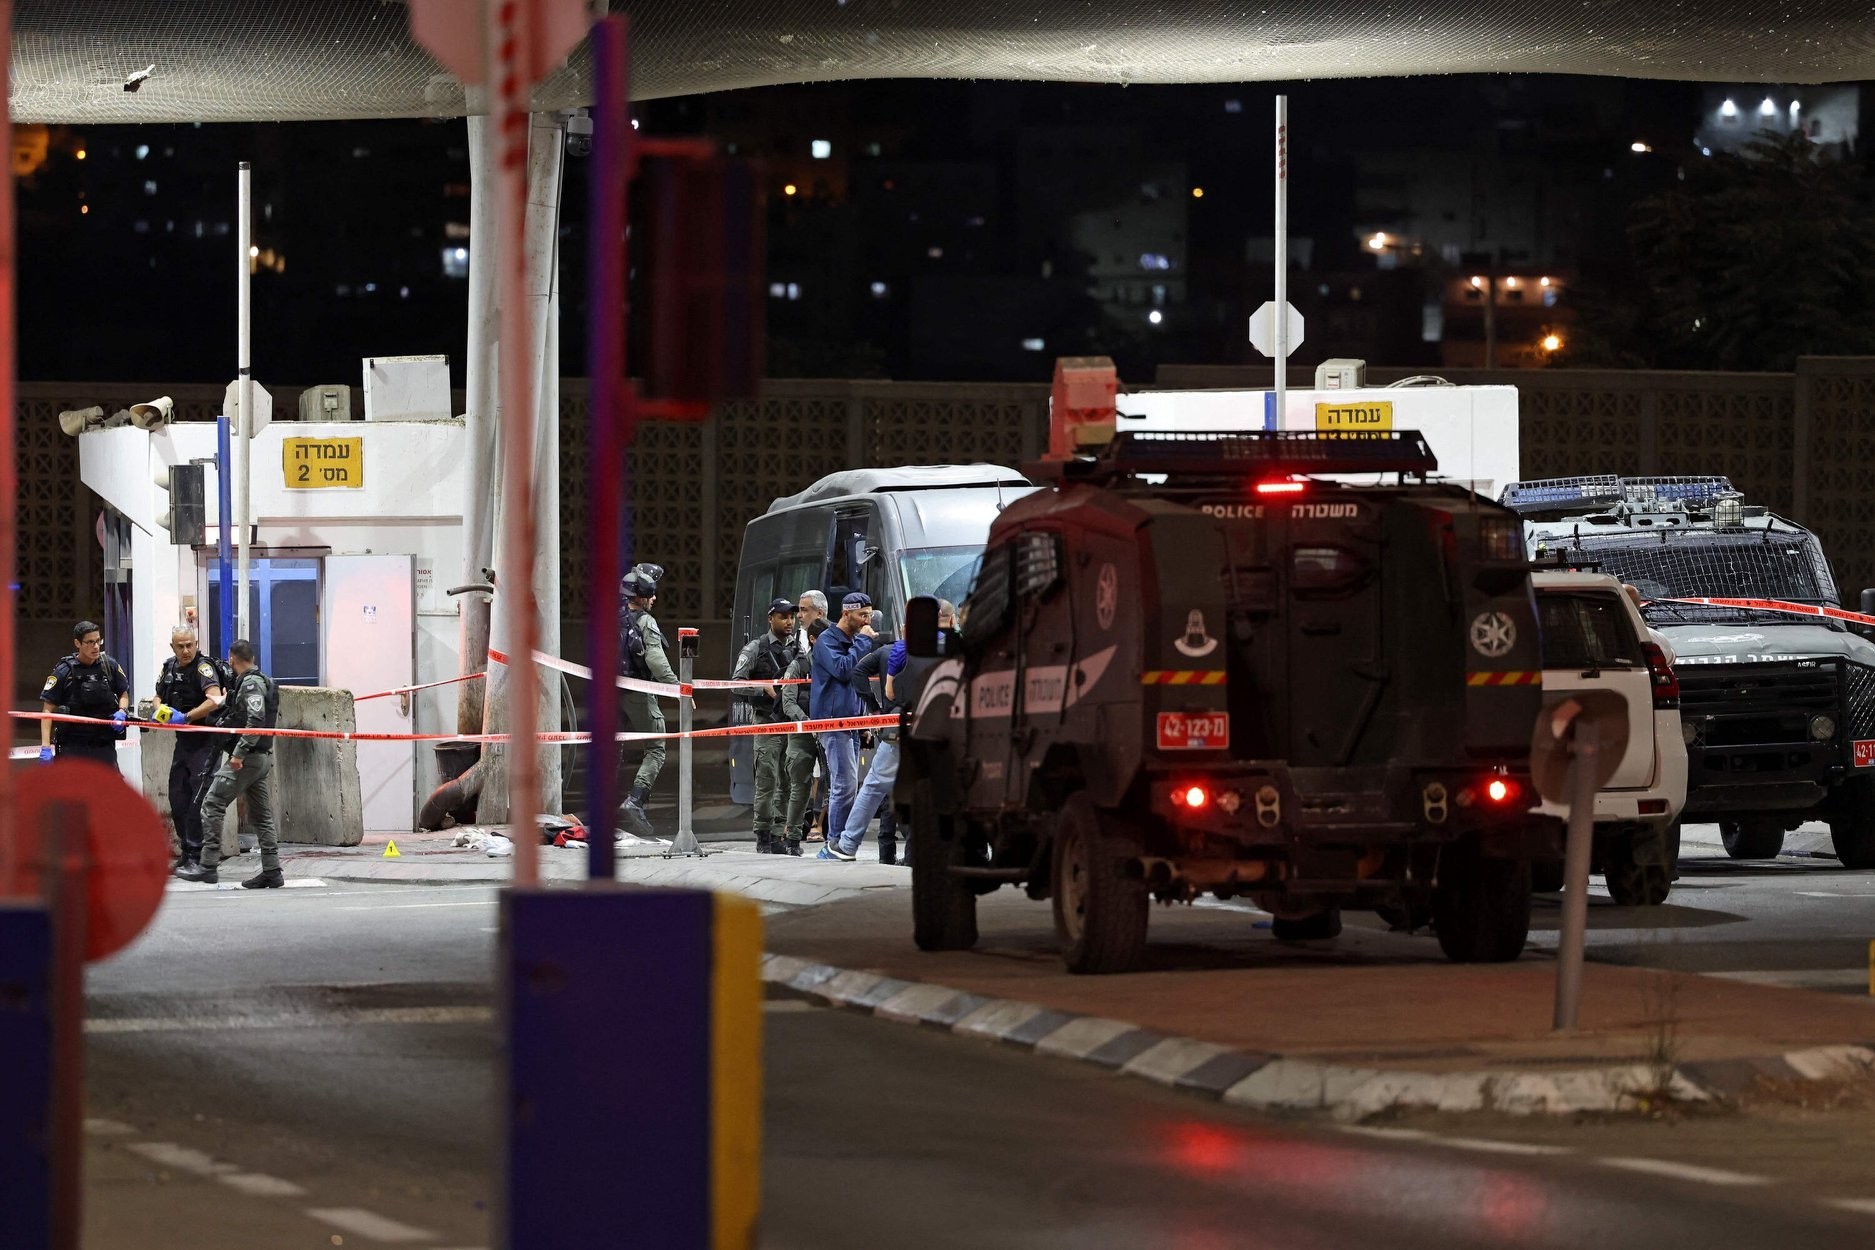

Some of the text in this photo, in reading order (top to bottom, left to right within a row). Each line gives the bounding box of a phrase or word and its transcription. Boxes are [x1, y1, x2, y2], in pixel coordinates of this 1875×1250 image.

[1328, 408, 1381, 424] עמדה
[295, 444, 350, 459] עמדה
[298, 464, 310, 482] 2
[1202, 504, 1265, 519] POLICE
[1291, 503, 1358, 519] משטרה
[978, 684, 1010, 709] POLICE
[803, 723, 823, 731] מעבר
